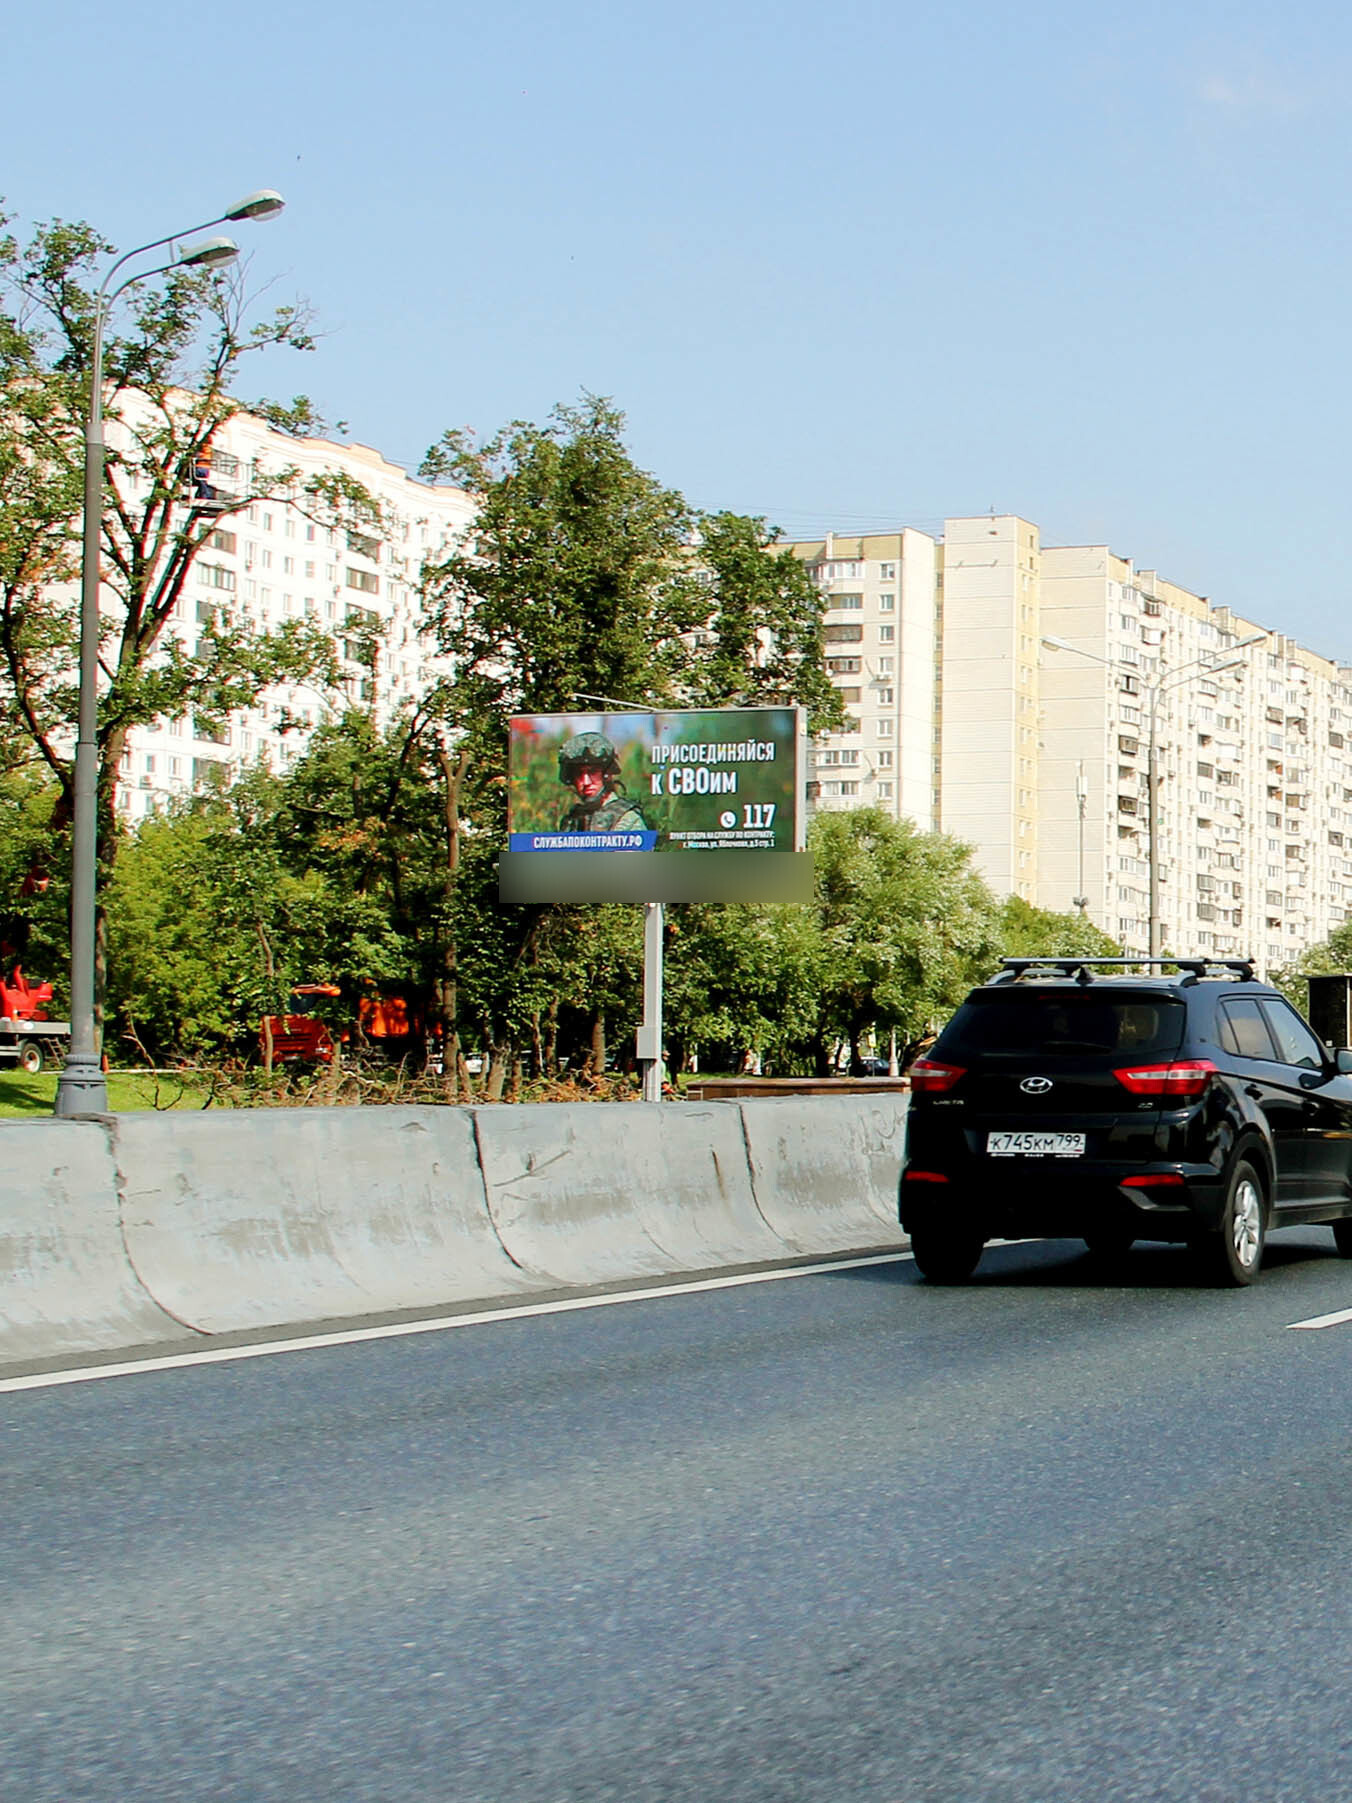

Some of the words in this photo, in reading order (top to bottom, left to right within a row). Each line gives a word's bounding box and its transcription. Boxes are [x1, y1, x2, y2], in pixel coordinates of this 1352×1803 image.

[652, 739, 775, 764] ПРИСОЕДИНЯЙСЯ
[743, 804, 776, 829] 117
[533, 835, 643, 849] СЛУЖБАПОКОНТРАКТУ.РФ
